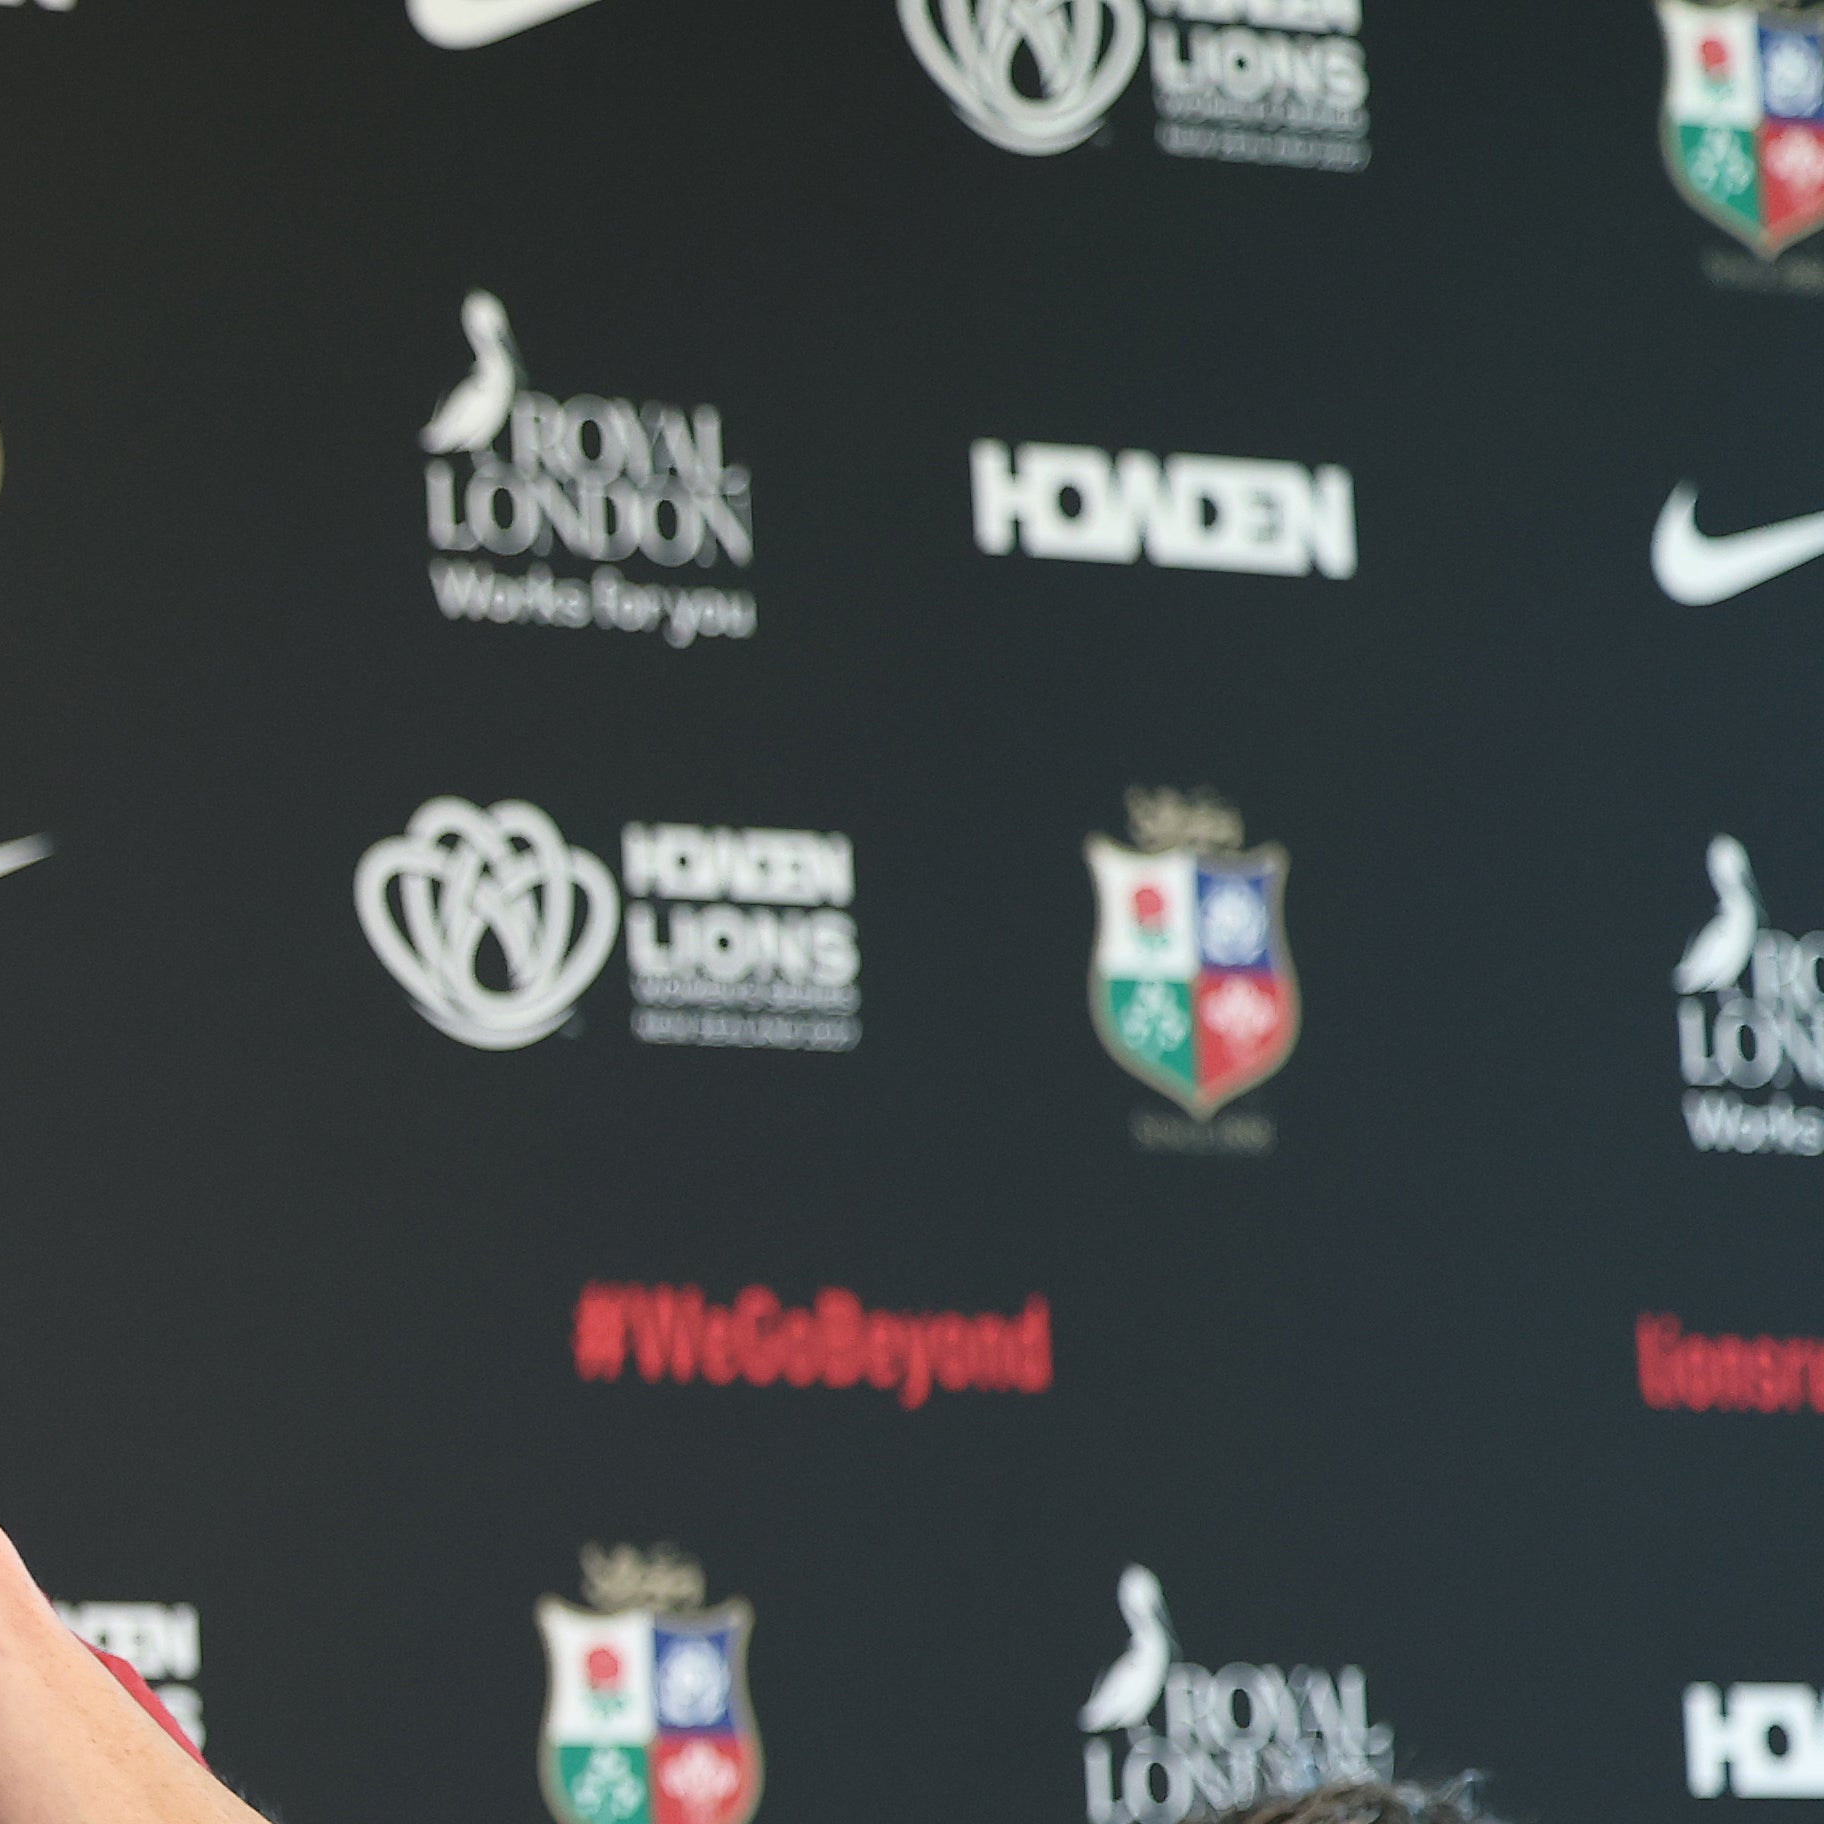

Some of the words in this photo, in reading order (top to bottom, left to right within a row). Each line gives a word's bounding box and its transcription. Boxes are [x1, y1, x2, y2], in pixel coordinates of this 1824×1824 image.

[510, 390, 751, 496] ROYAL
[425, 457, 753, 568] LONDON
[969, 437, 1359, 580] HOWDEN
[624, 900, 862, 988] LIONS
[572, 1279, 1053, 1411] #WeGoBeyond
